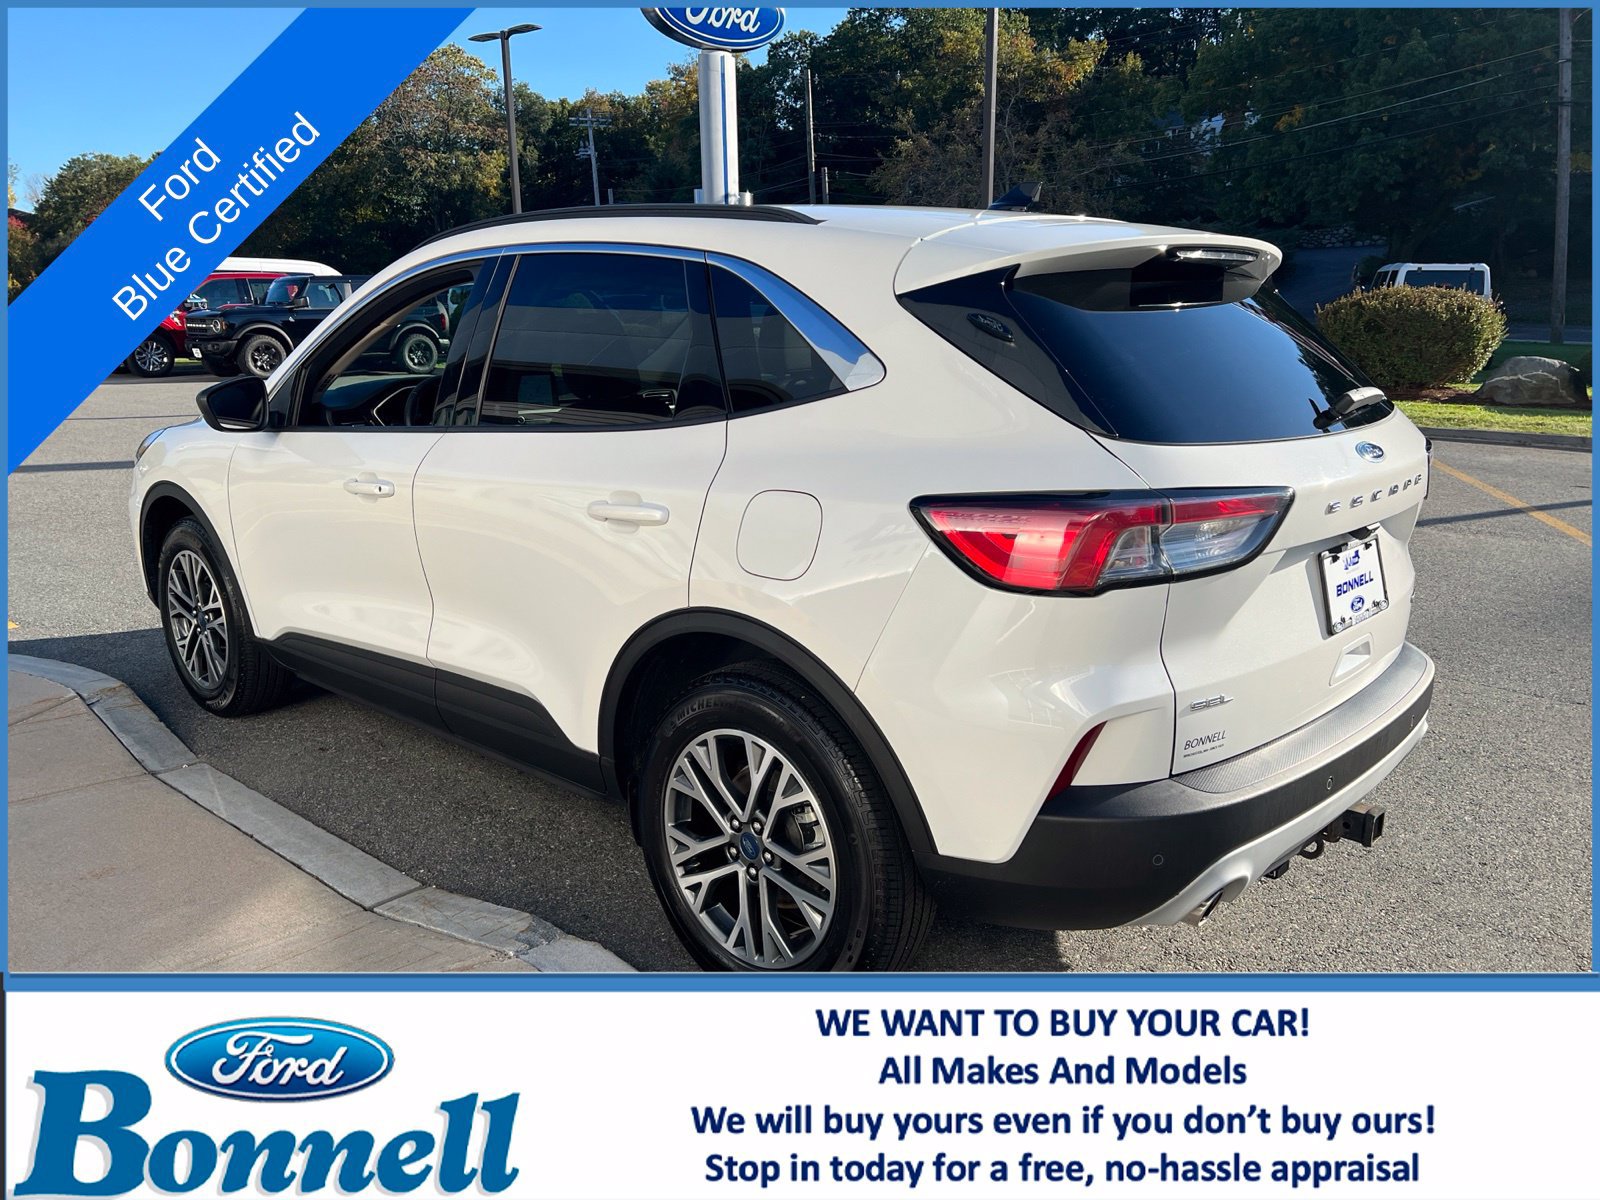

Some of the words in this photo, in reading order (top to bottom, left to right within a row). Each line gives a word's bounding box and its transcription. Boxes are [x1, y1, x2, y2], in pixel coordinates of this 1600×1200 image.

[1336, 571, 1374, 597] BONNELL
[1190, 695, 1234, 712] SEL
[1184, 730, 1226, 751] BONNELL
